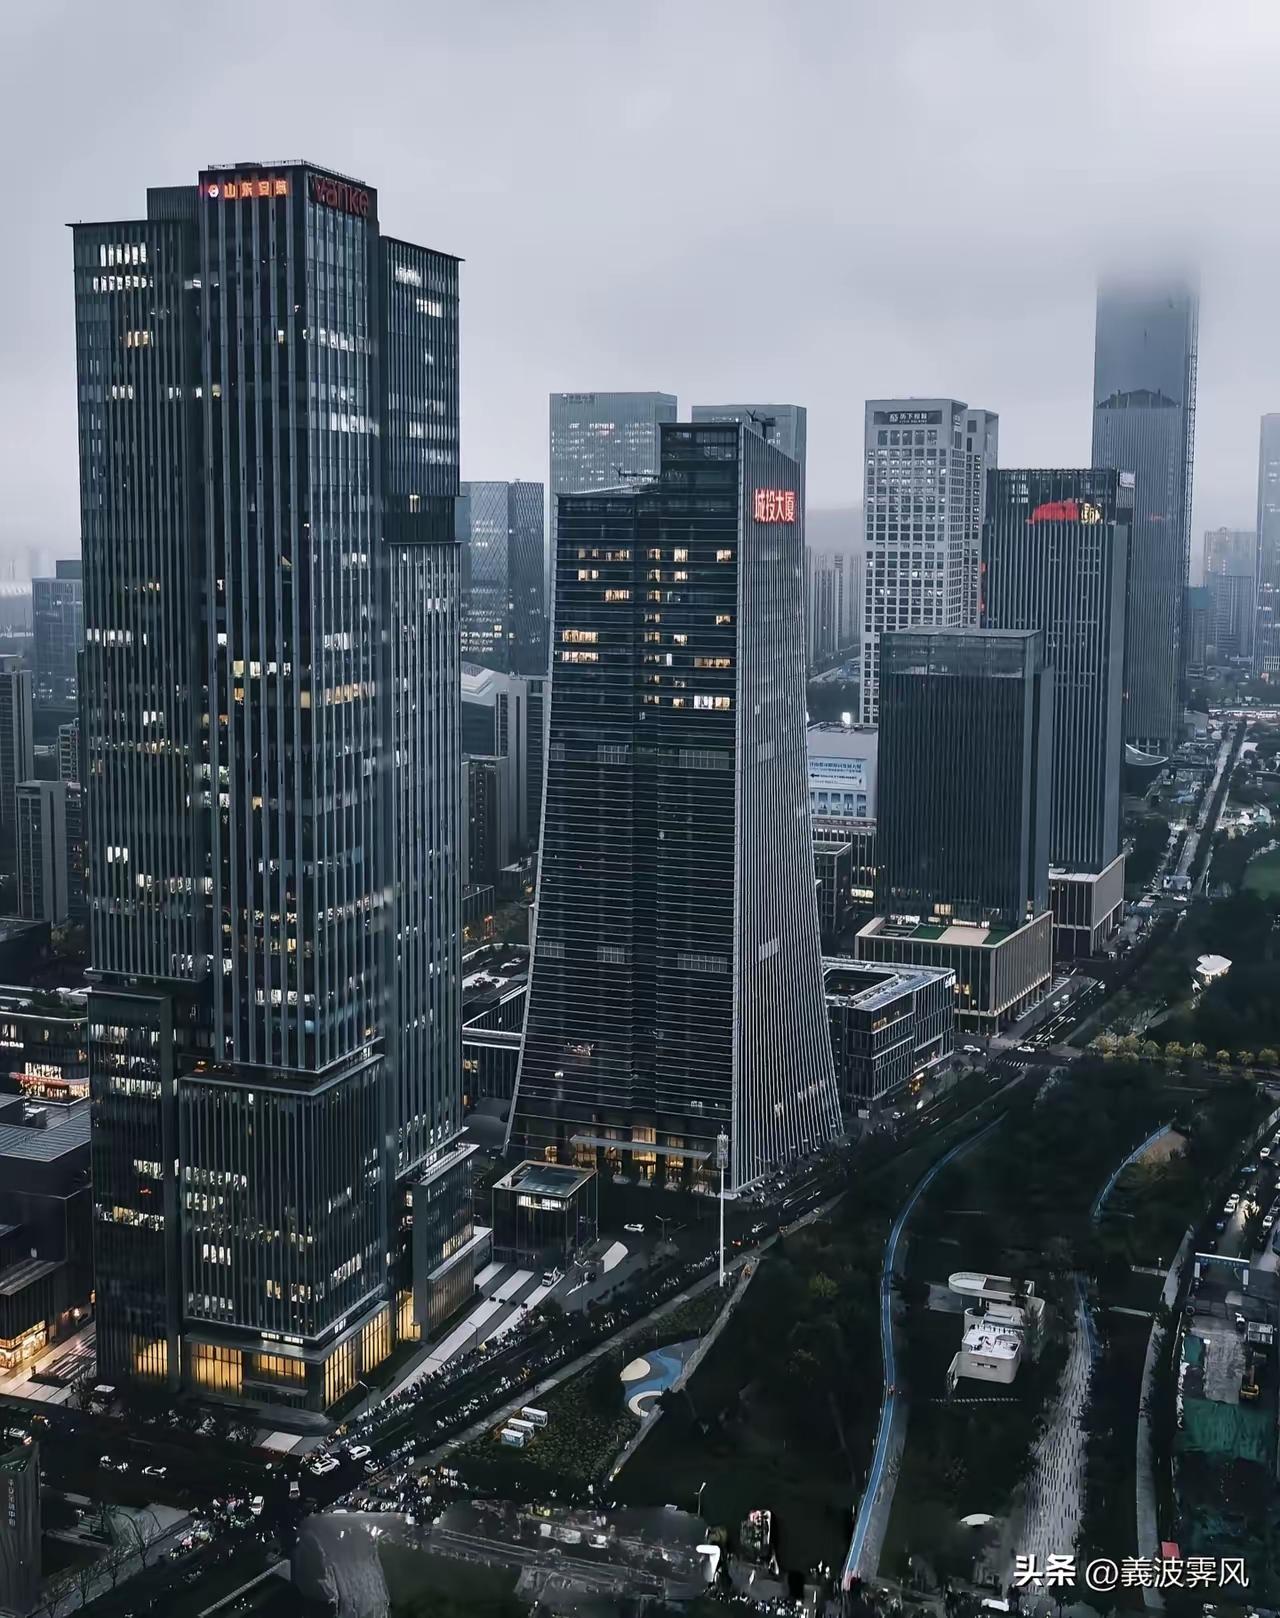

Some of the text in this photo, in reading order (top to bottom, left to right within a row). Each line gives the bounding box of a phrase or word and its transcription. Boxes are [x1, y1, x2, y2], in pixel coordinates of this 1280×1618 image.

[314, 177, 368, 216] vanke
[754, 488, 794, 522] 城投大厦
